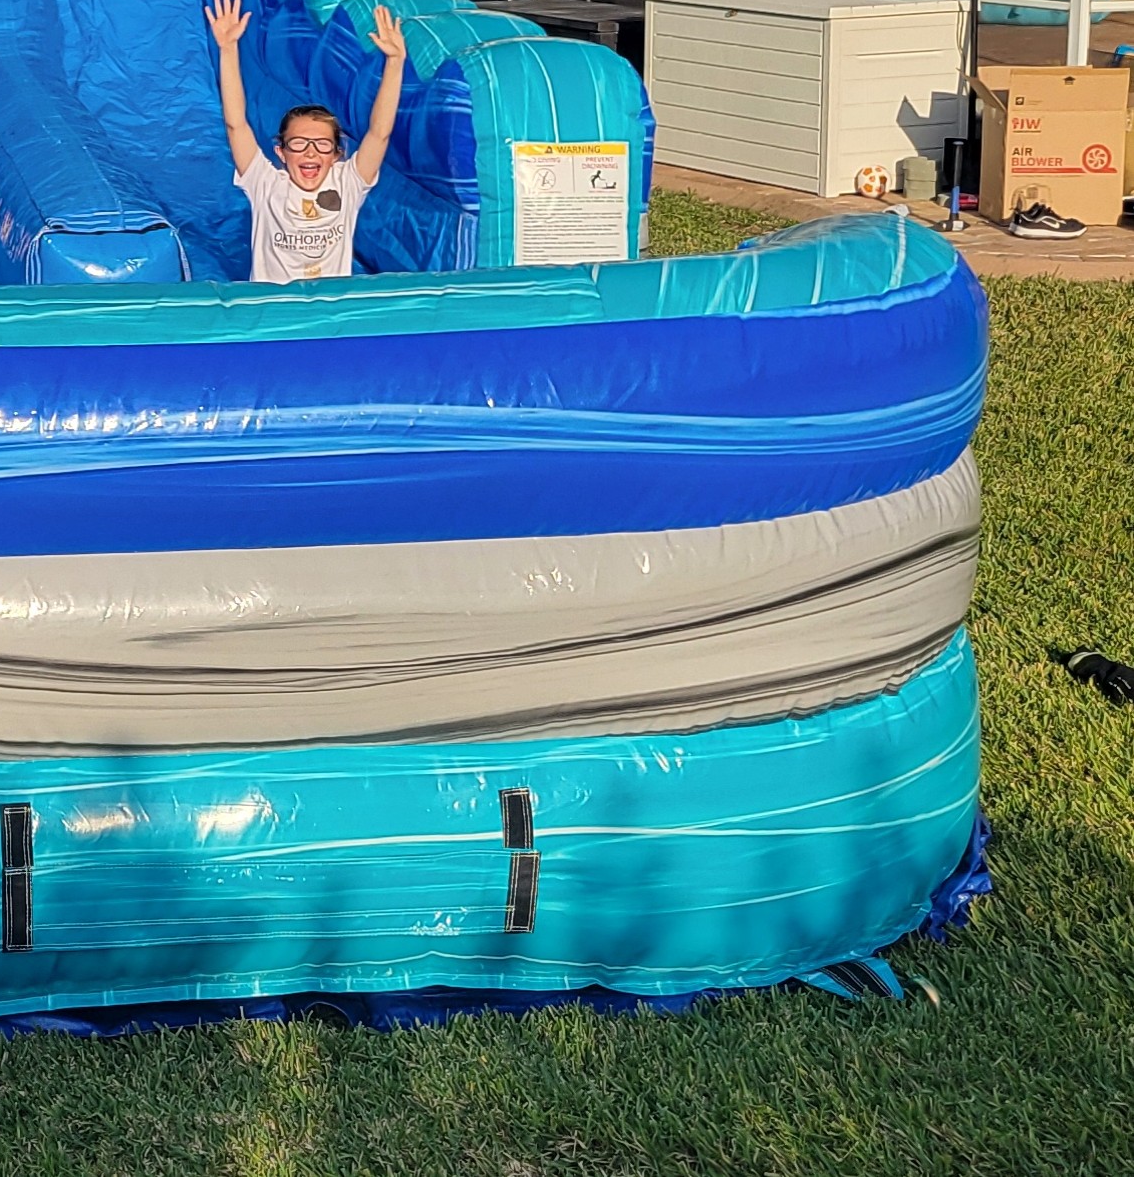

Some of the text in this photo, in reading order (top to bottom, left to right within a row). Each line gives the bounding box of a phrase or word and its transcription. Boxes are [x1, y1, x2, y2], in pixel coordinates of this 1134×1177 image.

[557, 146, 600, 154] WARNING
[1012, 147, 1033, 156] AIR
[1011, 157, 1063, 166] BLOWER
